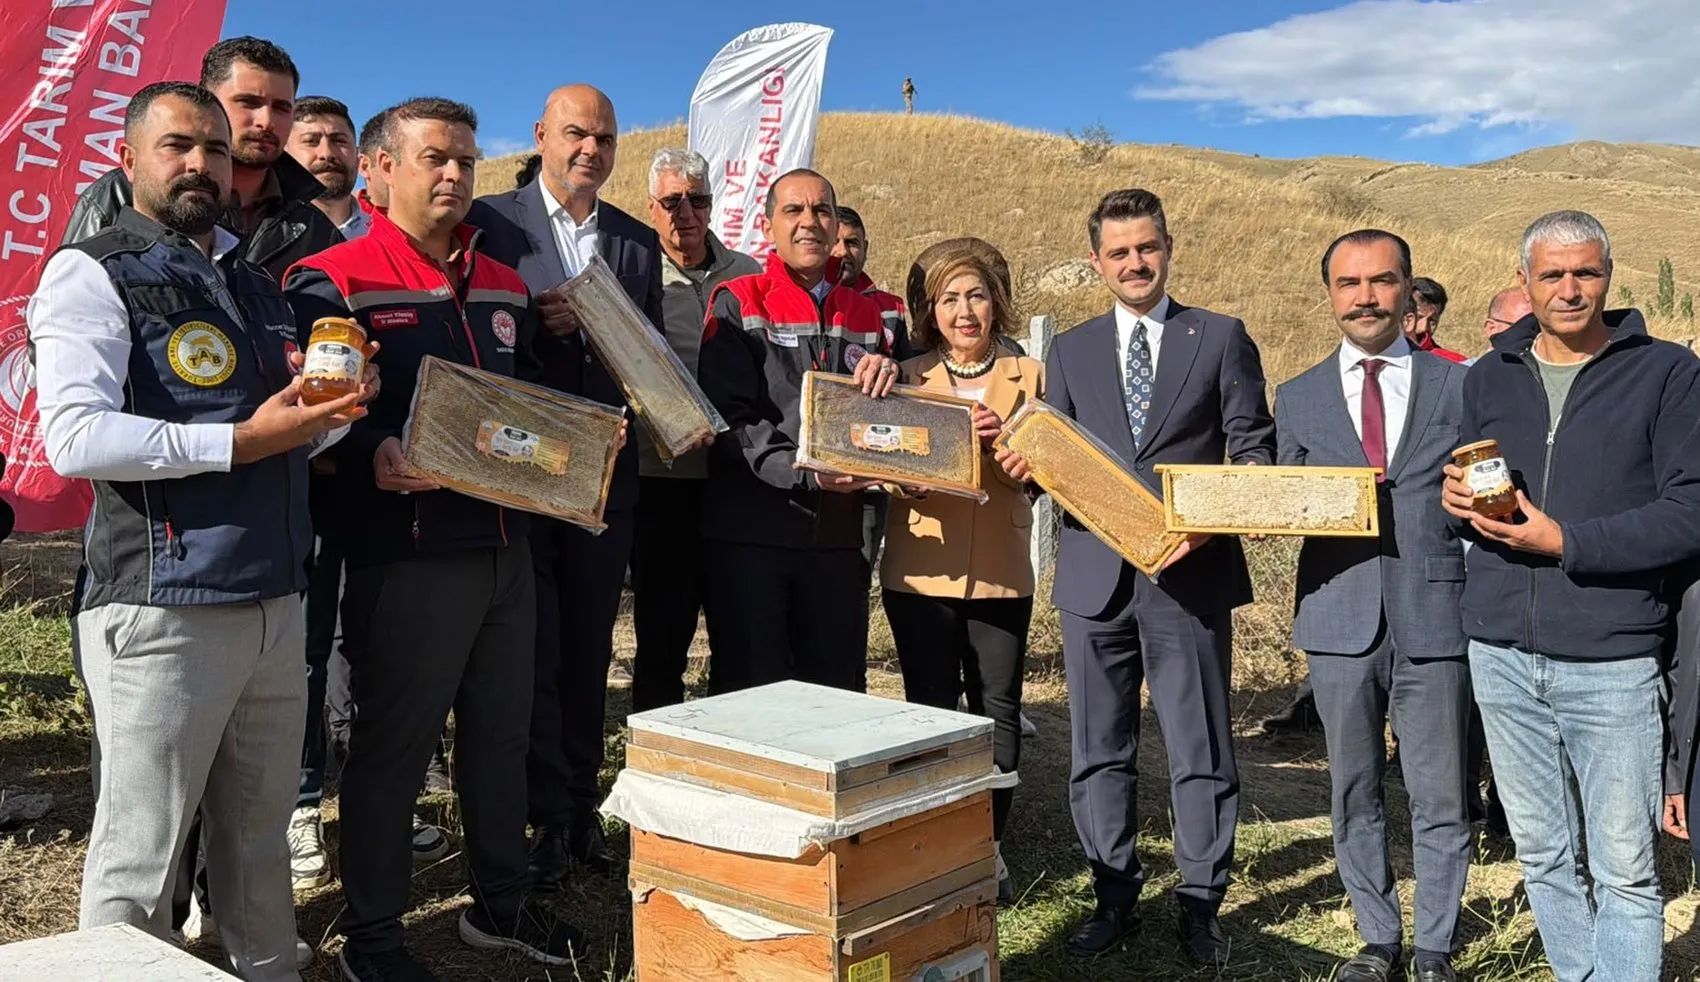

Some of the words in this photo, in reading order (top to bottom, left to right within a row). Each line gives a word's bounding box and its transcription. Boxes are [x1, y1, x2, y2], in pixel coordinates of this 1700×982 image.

[98, 0, 151, 77] BA
[15, 25, 87, 172] TARIM
[75, 89, 132, 195] MAN
[725, 160, 746, 197] VE
[2, 189, 51, 260] T.C
[723, 207, 745, 249] RIM
[189, 350, 221, 366] TAB
